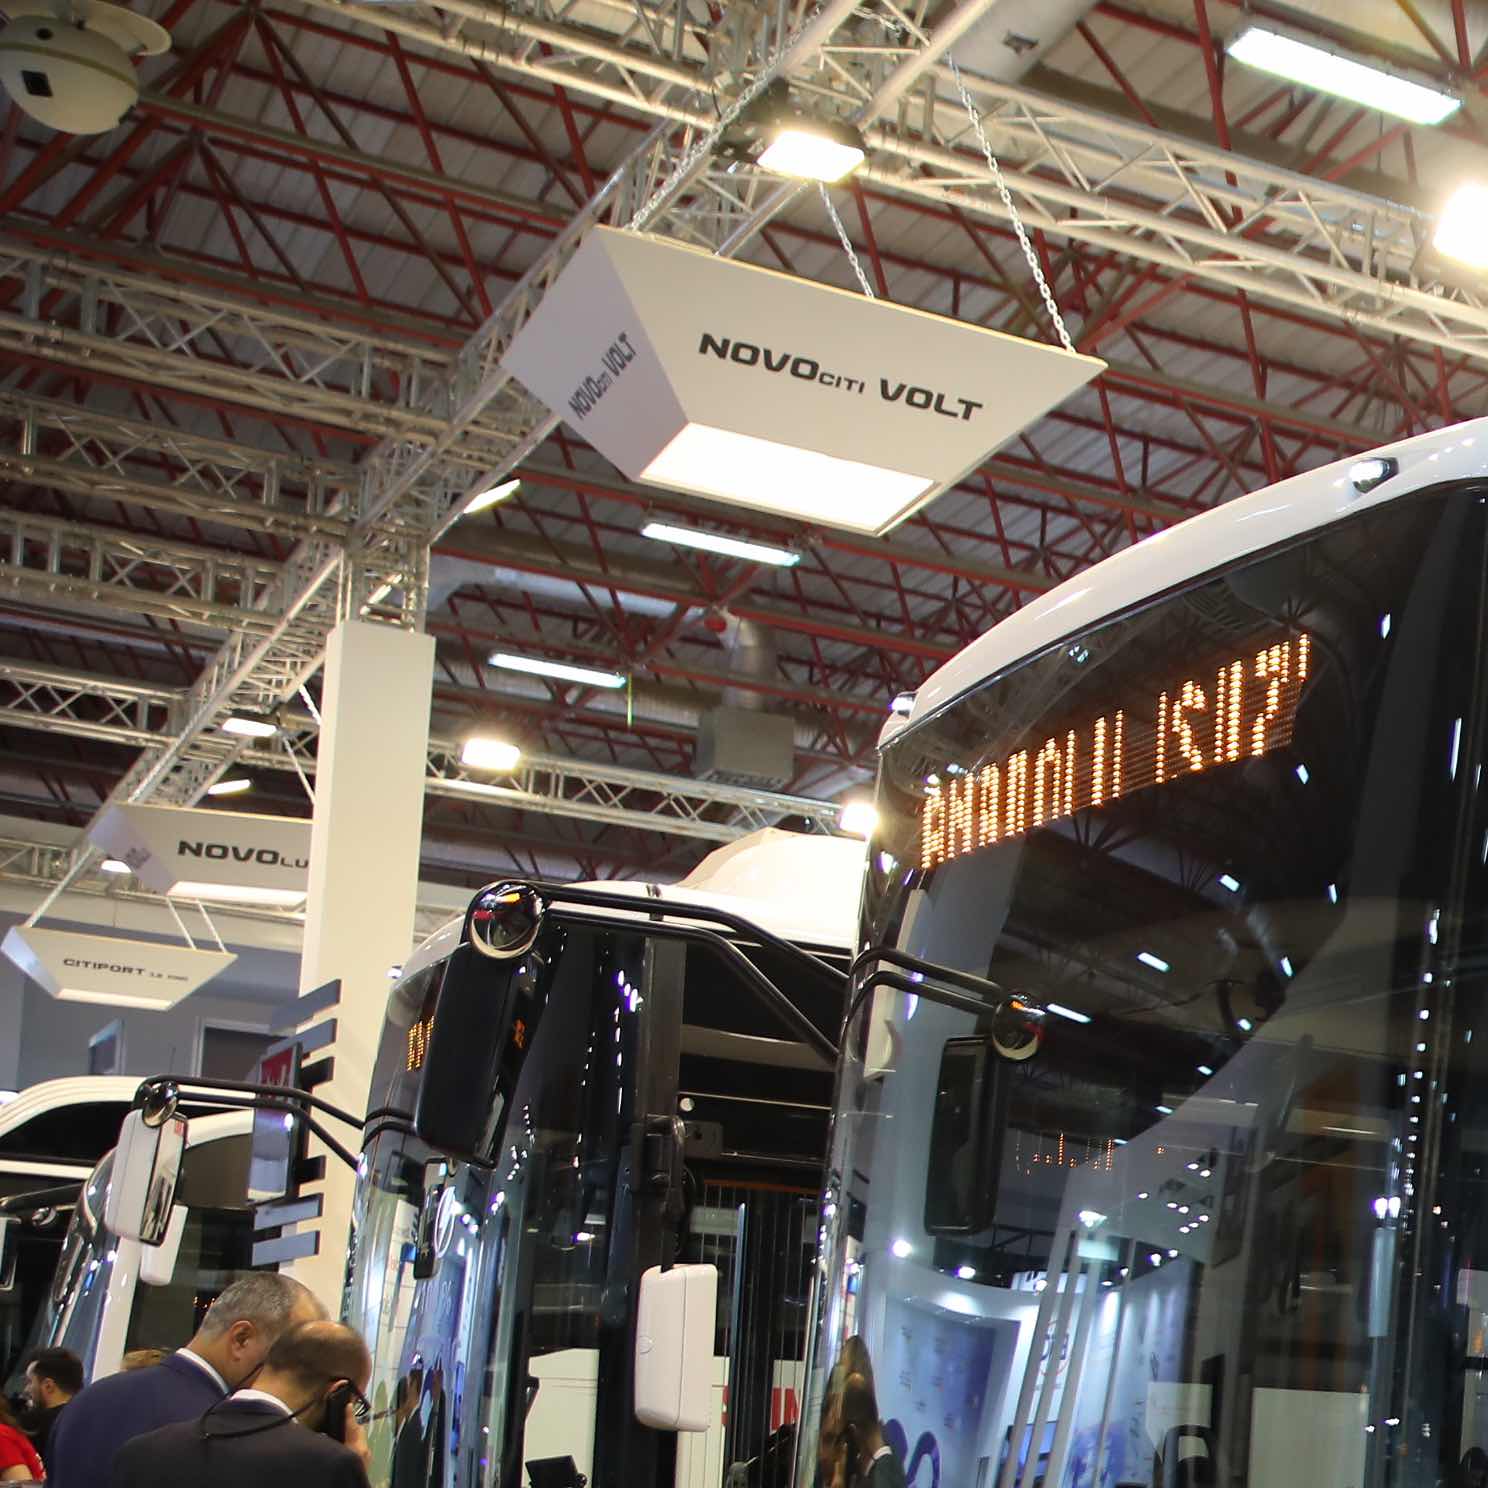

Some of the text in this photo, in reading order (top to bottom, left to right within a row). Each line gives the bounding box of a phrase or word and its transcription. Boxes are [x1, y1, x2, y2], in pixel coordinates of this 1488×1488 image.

[601, 332, 638, 377] VOLT
[879, 378, 984, 421] VOLT
[63, 957, 146, 975] CITIPORT
